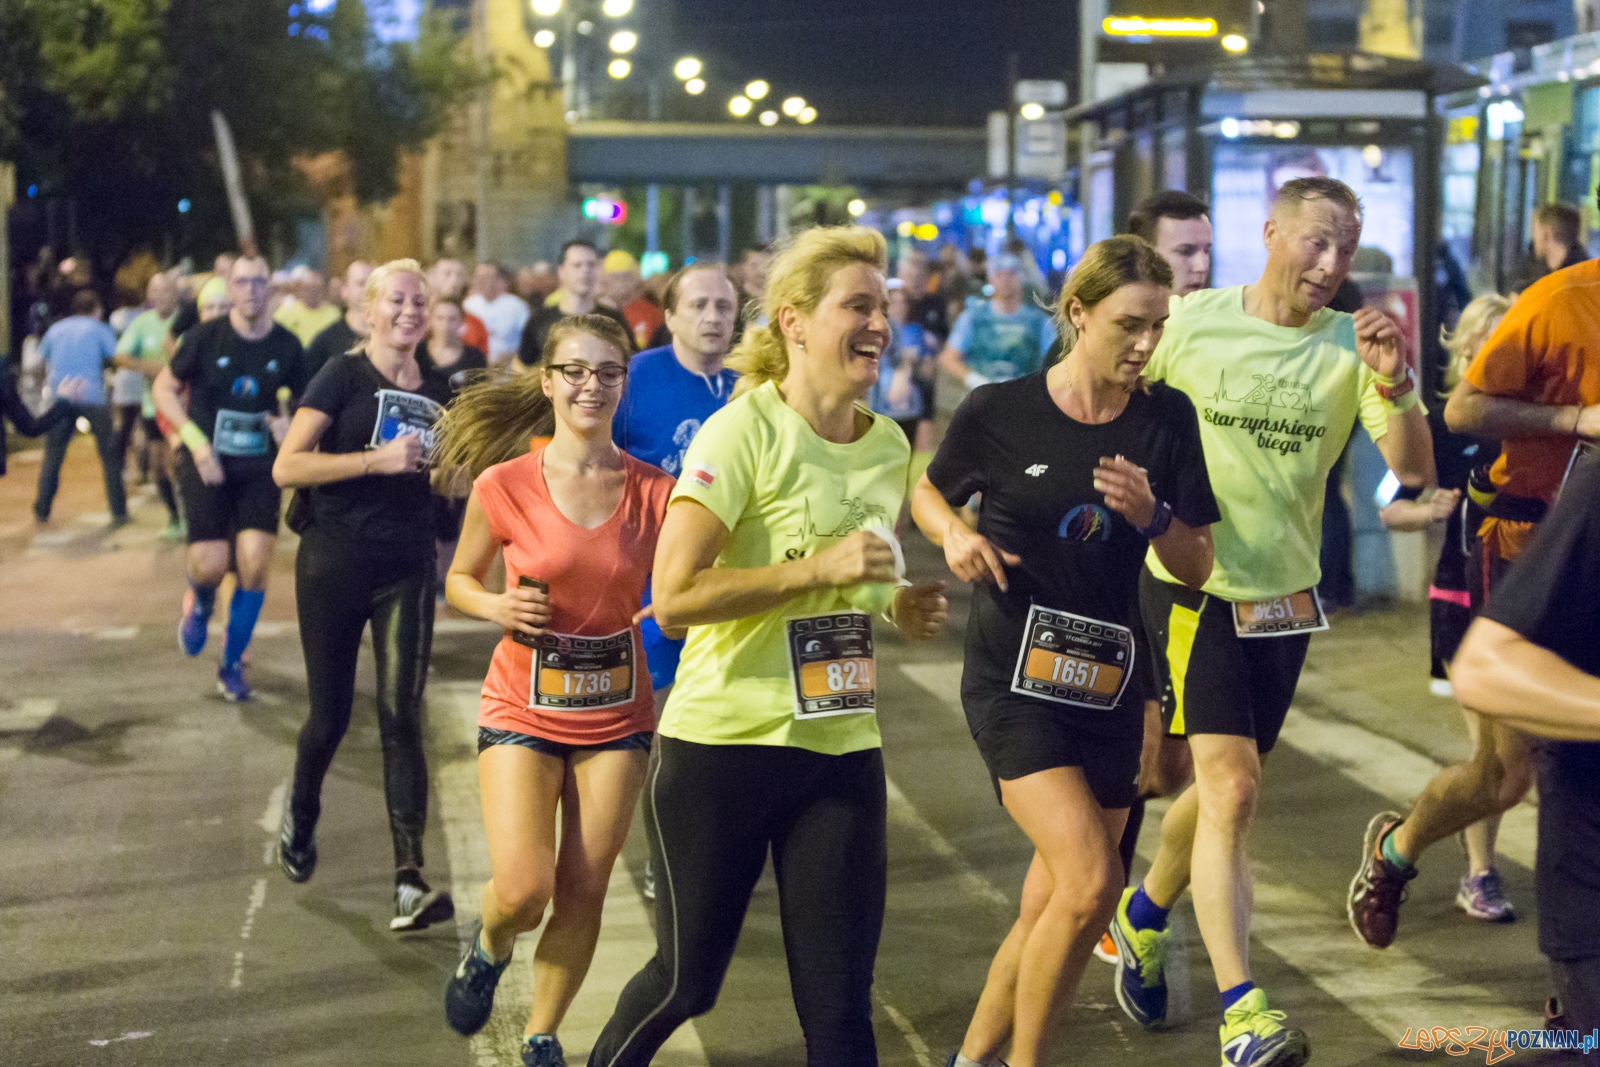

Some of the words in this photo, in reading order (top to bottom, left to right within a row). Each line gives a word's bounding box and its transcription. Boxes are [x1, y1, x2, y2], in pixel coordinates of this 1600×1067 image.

[1204, 407, 1326, 442] Starzyńskiego
[1257, 432, 1302, 456] biega
[1025, 463, 1049, 477] 4F
[562, 671, 611, 694] 1736
[1052, 656, 1099, 689] 1651
